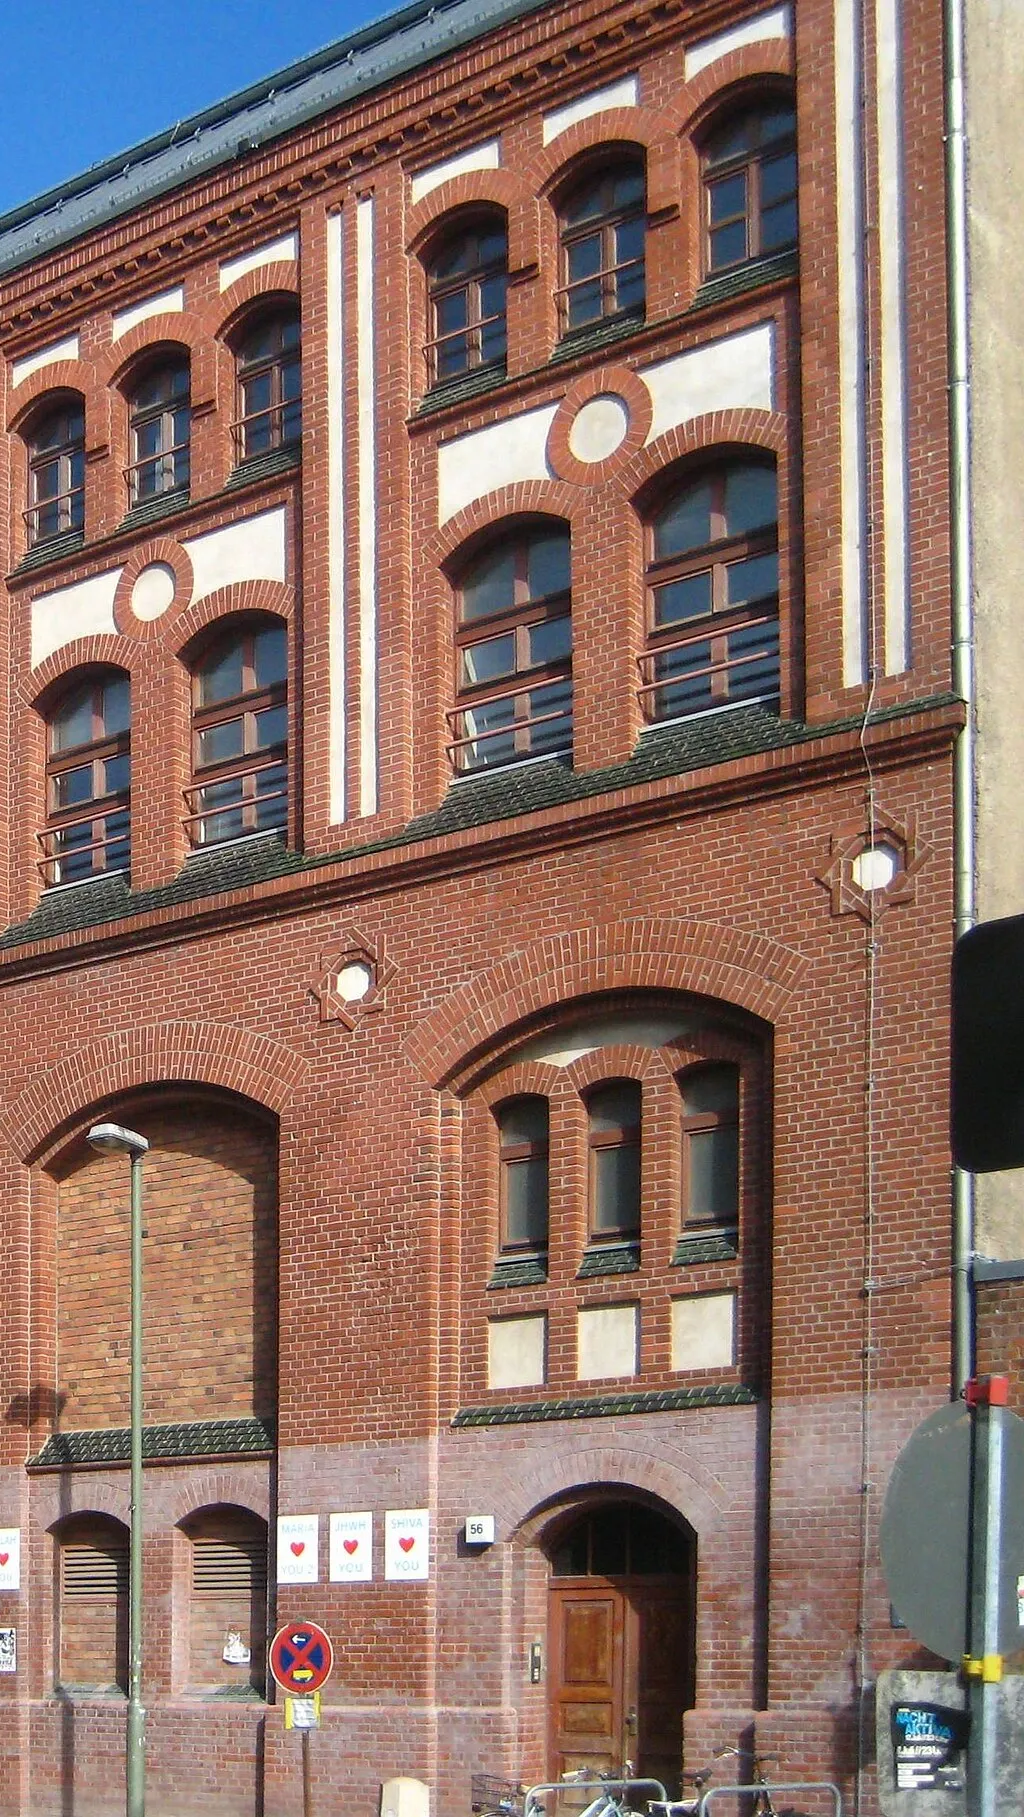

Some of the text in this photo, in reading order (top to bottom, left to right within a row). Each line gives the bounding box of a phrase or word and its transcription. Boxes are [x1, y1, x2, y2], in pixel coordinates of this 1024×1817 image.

[281, 1523, 315, 1534] MARIA
[335, 1521, 367, 1532] JHWH
[391, 1518, 423, 1529] SHIVA
[470, 1523, 483, 1534] 56
[281, 1564, 304, 1575] YOU
[338, 1562, 364, 1573] YOU
[394, 1560, 419, 1571] YOU
[897, 1711, 936, 1724] NACHT
